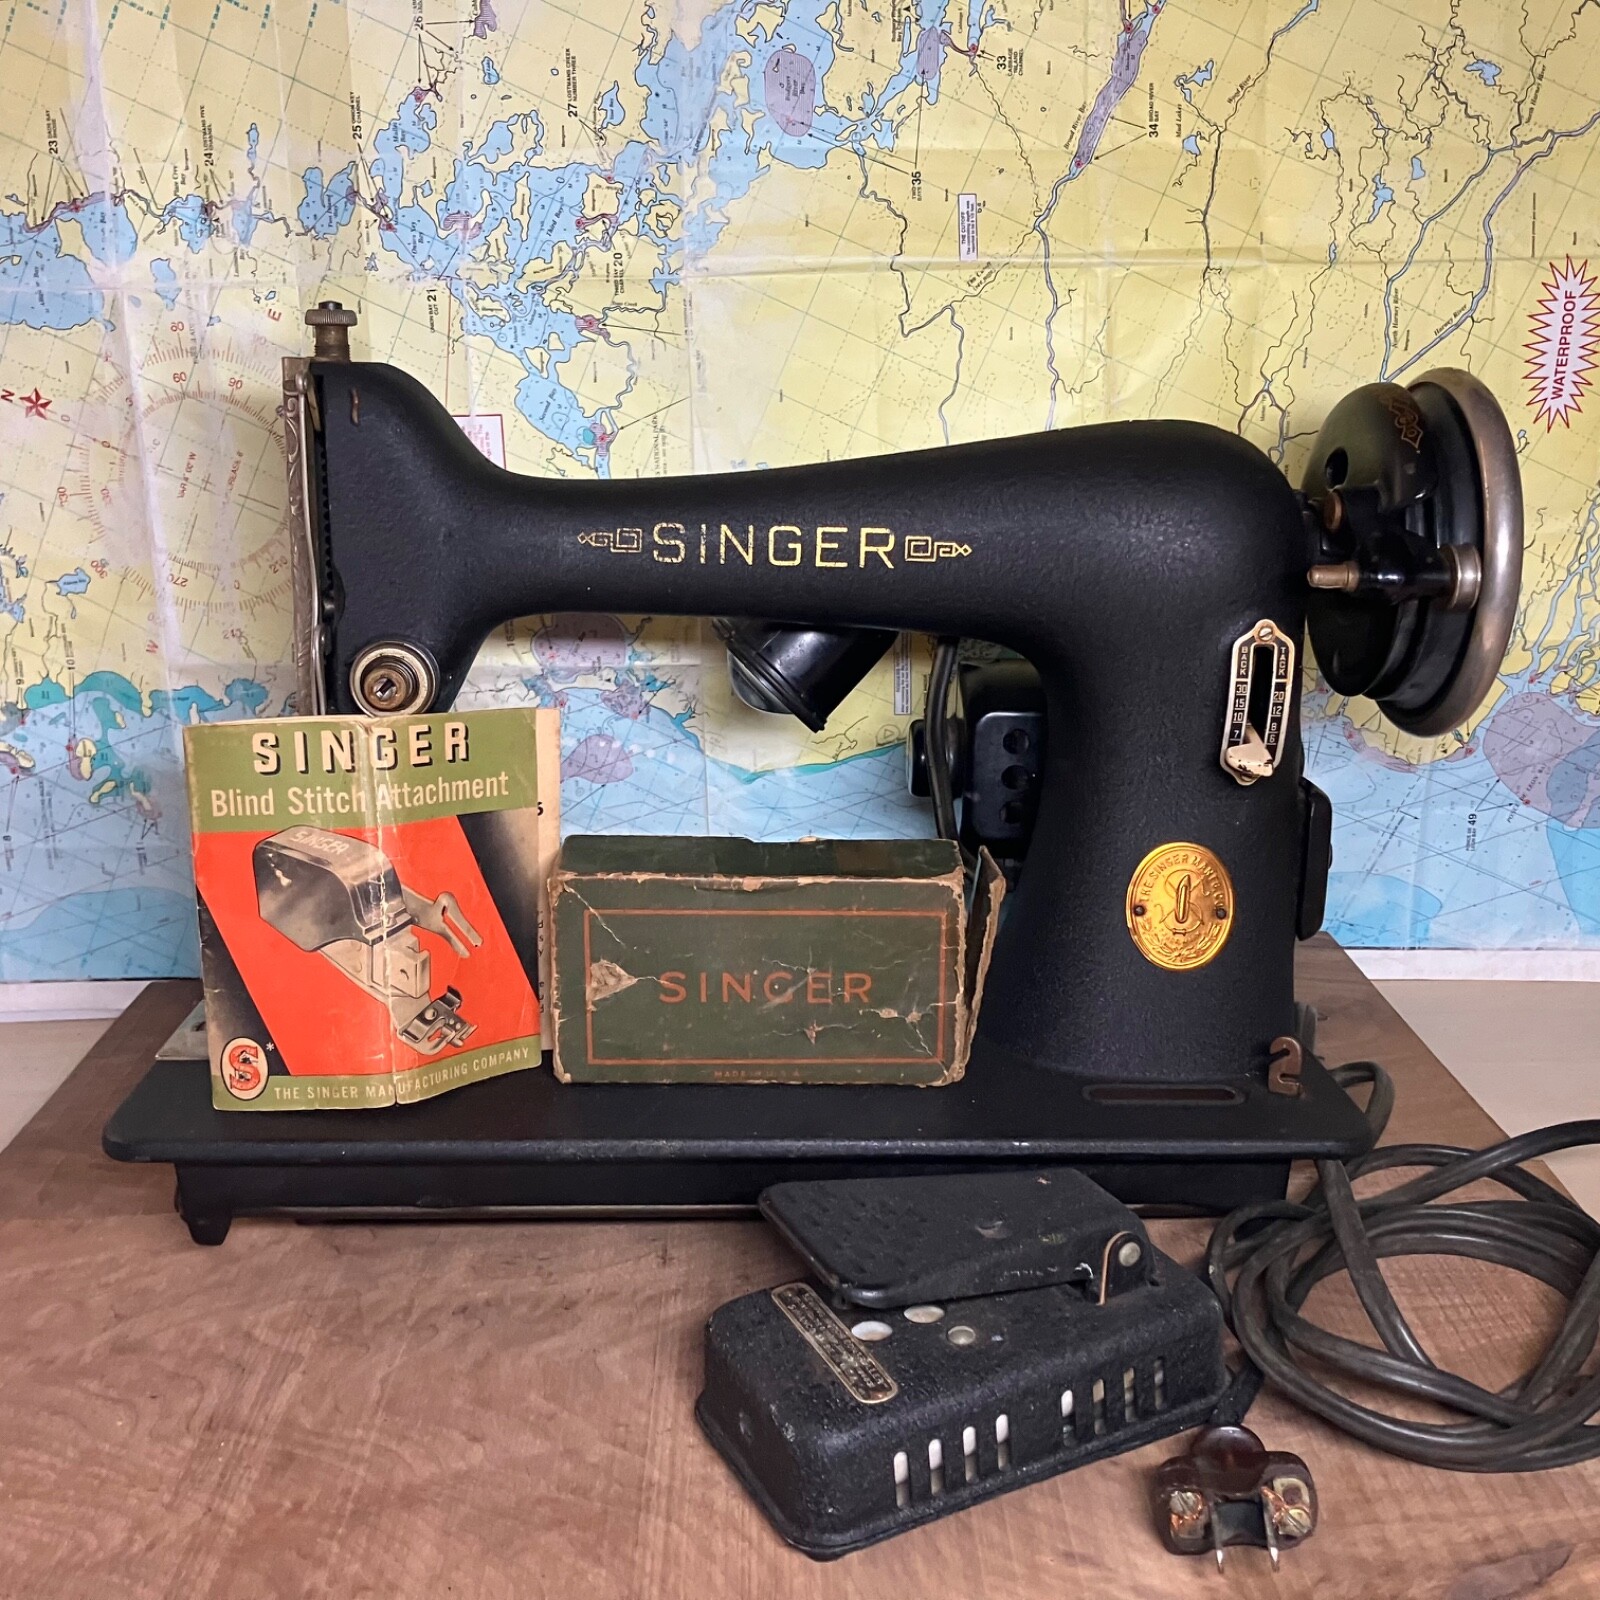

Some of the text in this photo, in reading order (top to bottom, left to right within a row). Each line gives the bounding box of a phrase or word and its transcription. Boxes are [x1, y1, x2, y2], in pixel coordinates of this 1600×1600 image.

[997, 56, 1006, 70] 33
[568, 103, 578, 118] 27
[352, 125, 362, 140] 25
[1148, 124, 1158, 138] 34
[48, 140, 58, 154] 23
[204, 152, 214, 166] 24
[912, 172, 922, 185] 35
[613, 252, 622, 266] 20
[426, 290, 437, 302] 21
[268, 308, 282, 322] E
[1550, 290, 1578, 400] WATERPROOF
[172, 372, 188, 382] 60
[228, 378, 243, 390] 90
[0, 388, 15, 403] N
[652, 522, 896, 569] SINGER
[90, 560, 108, 579] 300
[168, 573, 188, 587] 270
[66, 657, 74, 670] 10
[1240, 646, 1249, 676] BACK
[1278, 646, 1287, 676] TACK
[1236, 684, 1248, 694] 30
[1273, 691, 1285, 701] 20
[1234, 698, 1245, 708] 15
[1233, 712, 1243, 722] 10
[1272, 706, 1283, 716] 12
[1270, 722, 1278, 732] 8
[1234, 730, 1240, 740] 7
[252, 722, 470, 776] SINGER
[211, 788, 275, 818] Blind
[288, 782, 368, 815] Stitch
[376, 771, 510, 814] Attachment
[1468, 814, 1477, 826] 49
[291, 830, 350, 855] SINGER
[1148, 854, 1190, 881] SINGER
[658, 970, 874, 1005] SINGER
[230, 1044, 262, 1092] S
[274, 1047, 530, 1100] THE SINGER MANUFACTURING COMPANY
